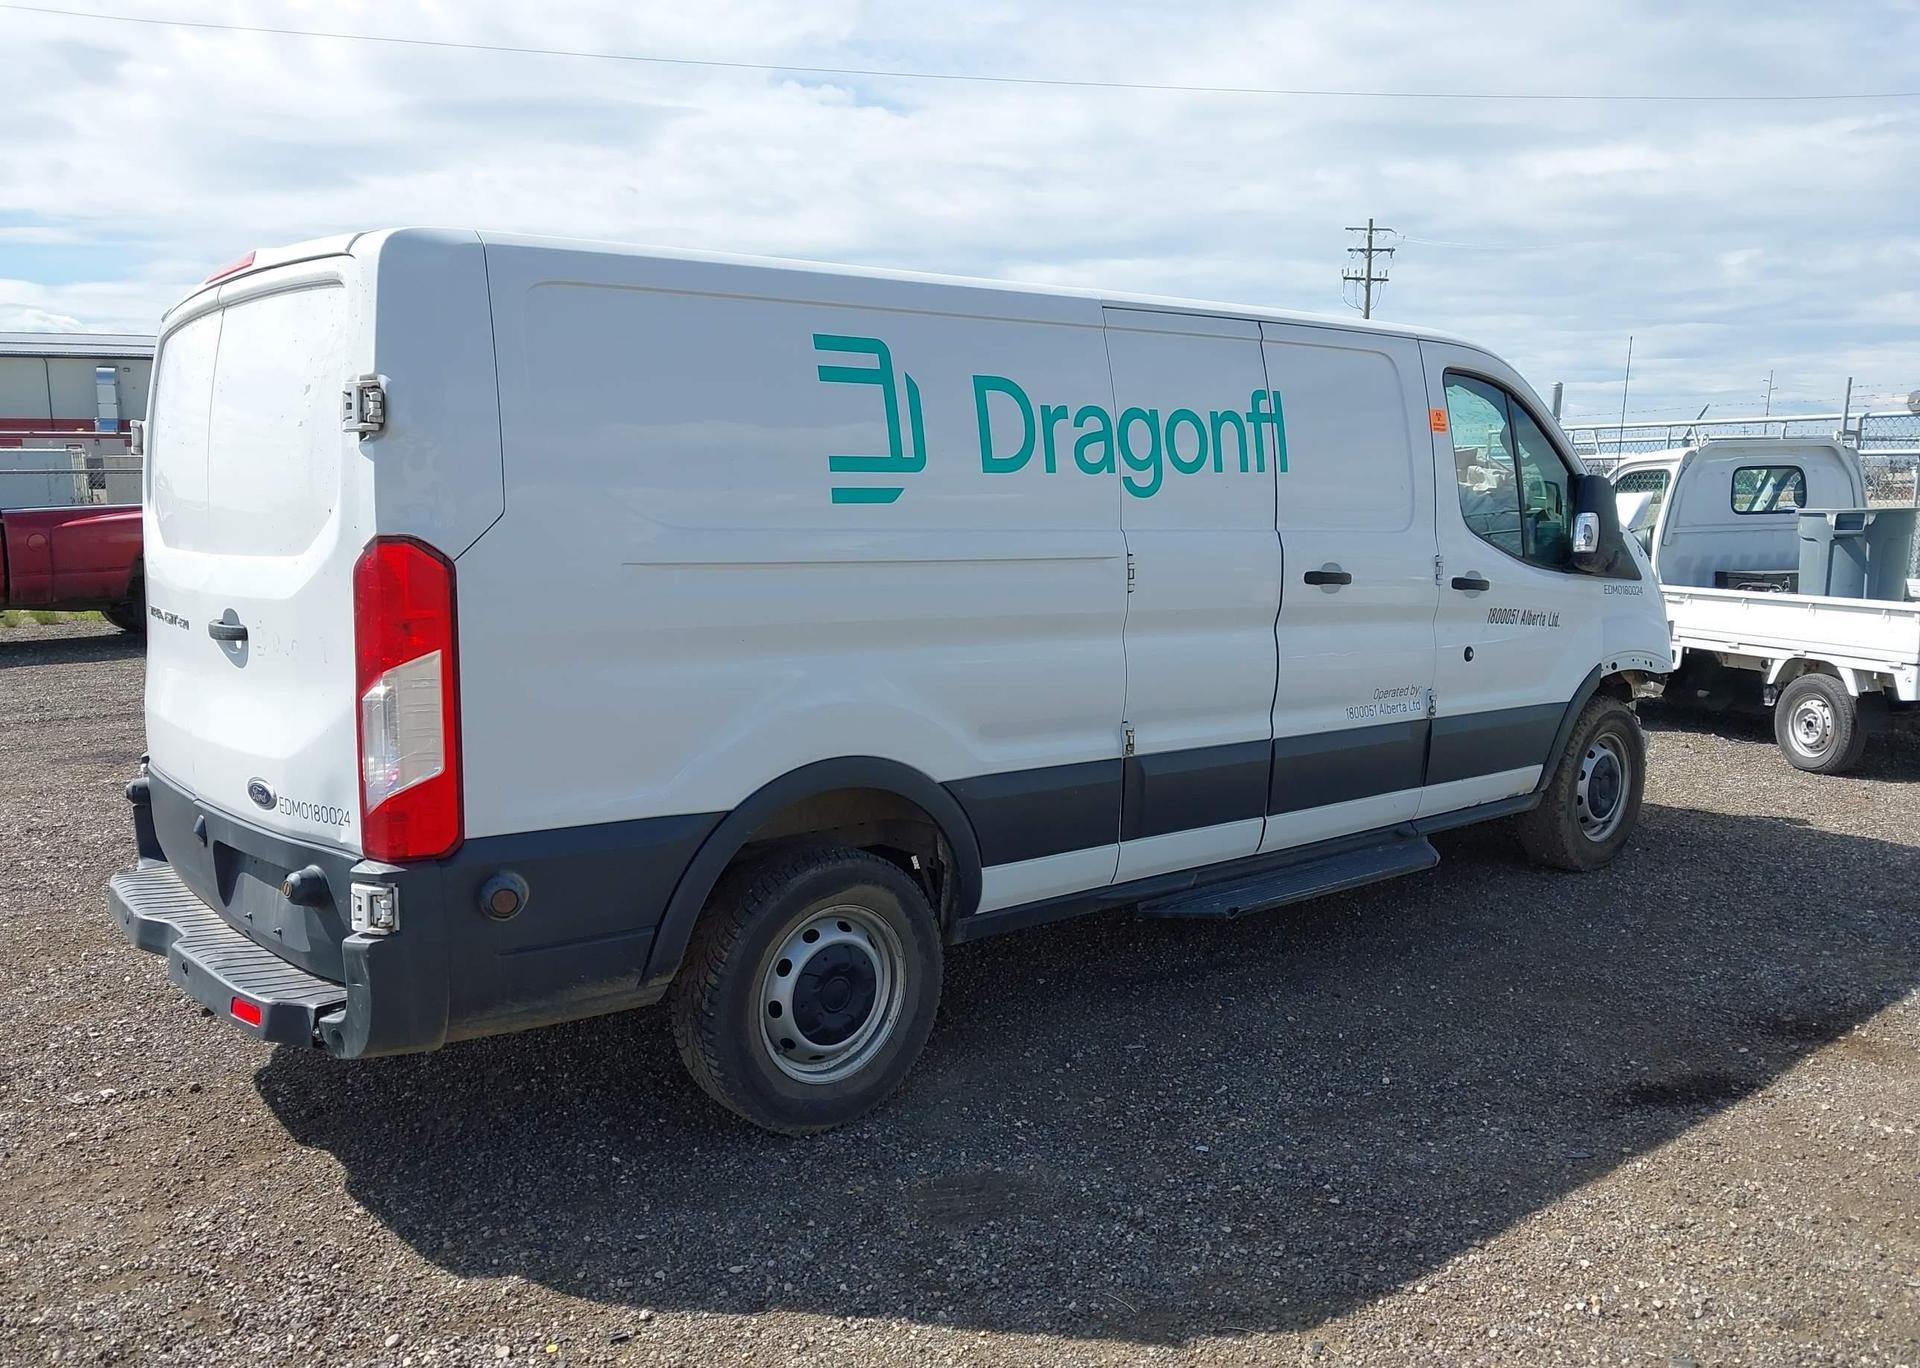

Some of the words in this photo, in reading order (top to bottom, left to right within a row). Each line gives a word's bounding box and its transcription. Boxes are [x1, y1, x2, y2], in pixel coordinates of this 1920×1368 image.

[972, 374, 1289, 498] Dragonfl
[1487, 607, 1520, 625] 1800051
[1520, 609, 1547, 627] Alberta
[1548, 611, 1560, 628] Ltd.
[1373, 684, 1410, 702] Operated
[1346, 703, 1378, 720] 1800051
[1379, 701, 1407, 715] Alberta
[1408, 699, 1421, 712] Ltd
